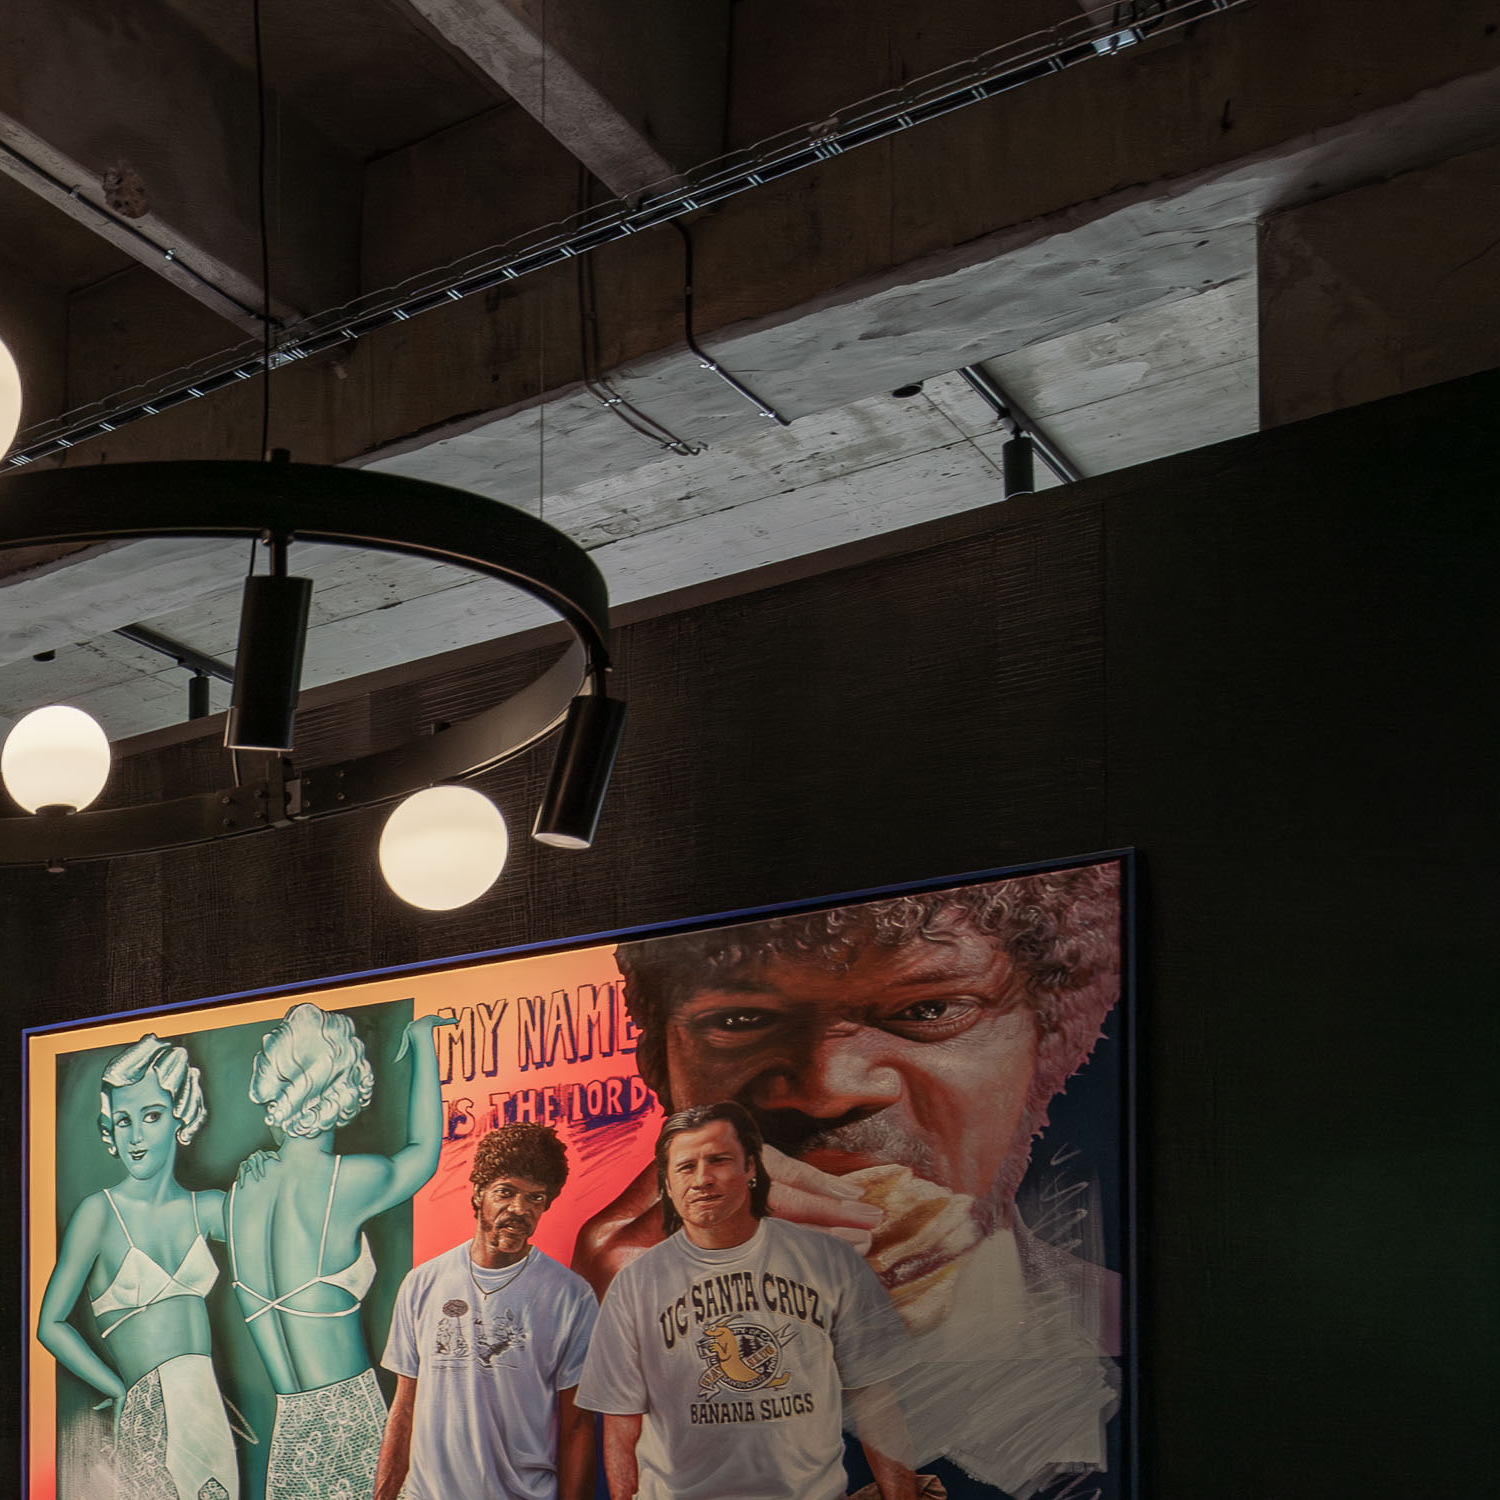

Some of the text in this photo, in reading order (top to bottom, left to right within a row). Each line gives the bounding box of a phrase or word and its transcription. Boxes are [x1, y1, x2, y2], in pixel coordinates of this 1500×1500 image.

[437, 979, 643, 1085] MY NAME
[489, 1086, 560, 1129] THE
[570, 1075, 650, 1124] LORD
[660, 1272, 825, 1349] UC SANTA CRUZ
[691, 1393, 814, 1425] BANANA SLUGS
